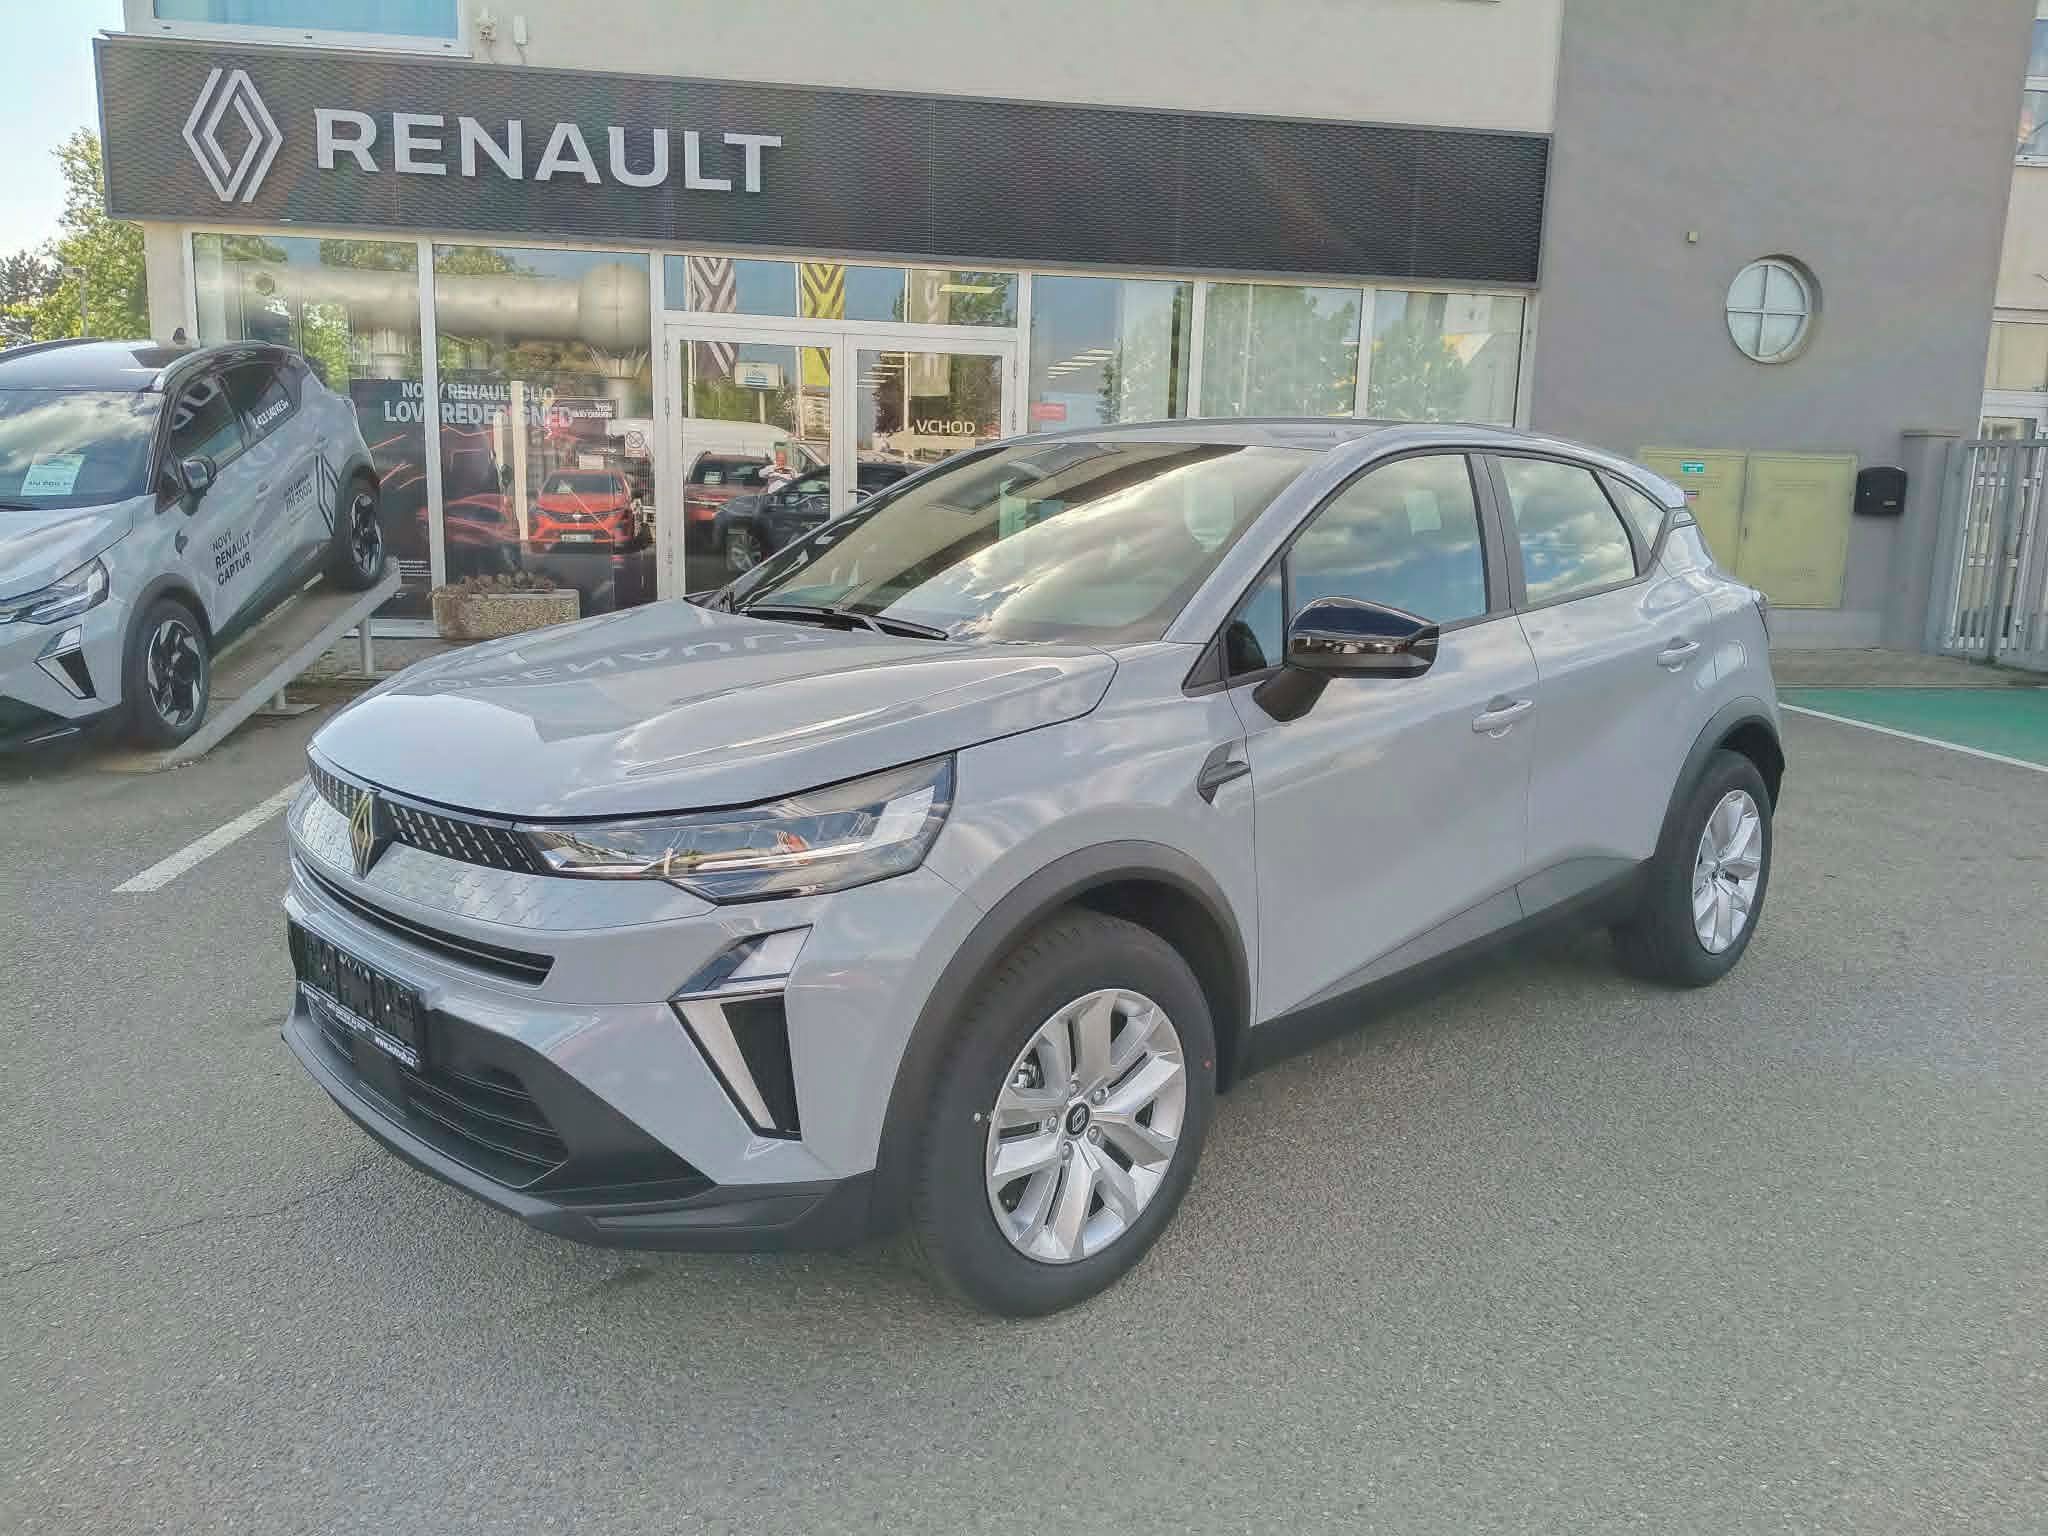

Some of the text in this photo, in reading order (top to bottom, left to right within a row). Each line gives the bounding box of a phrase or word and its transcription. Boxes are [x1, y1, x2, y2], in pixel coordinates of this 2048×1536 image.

[314, 106, 783, 194] RENAULT
[448, 383, 515, 401] RENAUL
[384, 400, 424, 422] LOV
[915, 418, 976, 435] VCHOD
[215, 530, 251, 570] RENAULT
[217, 551, 252, 585] CAPTUR
